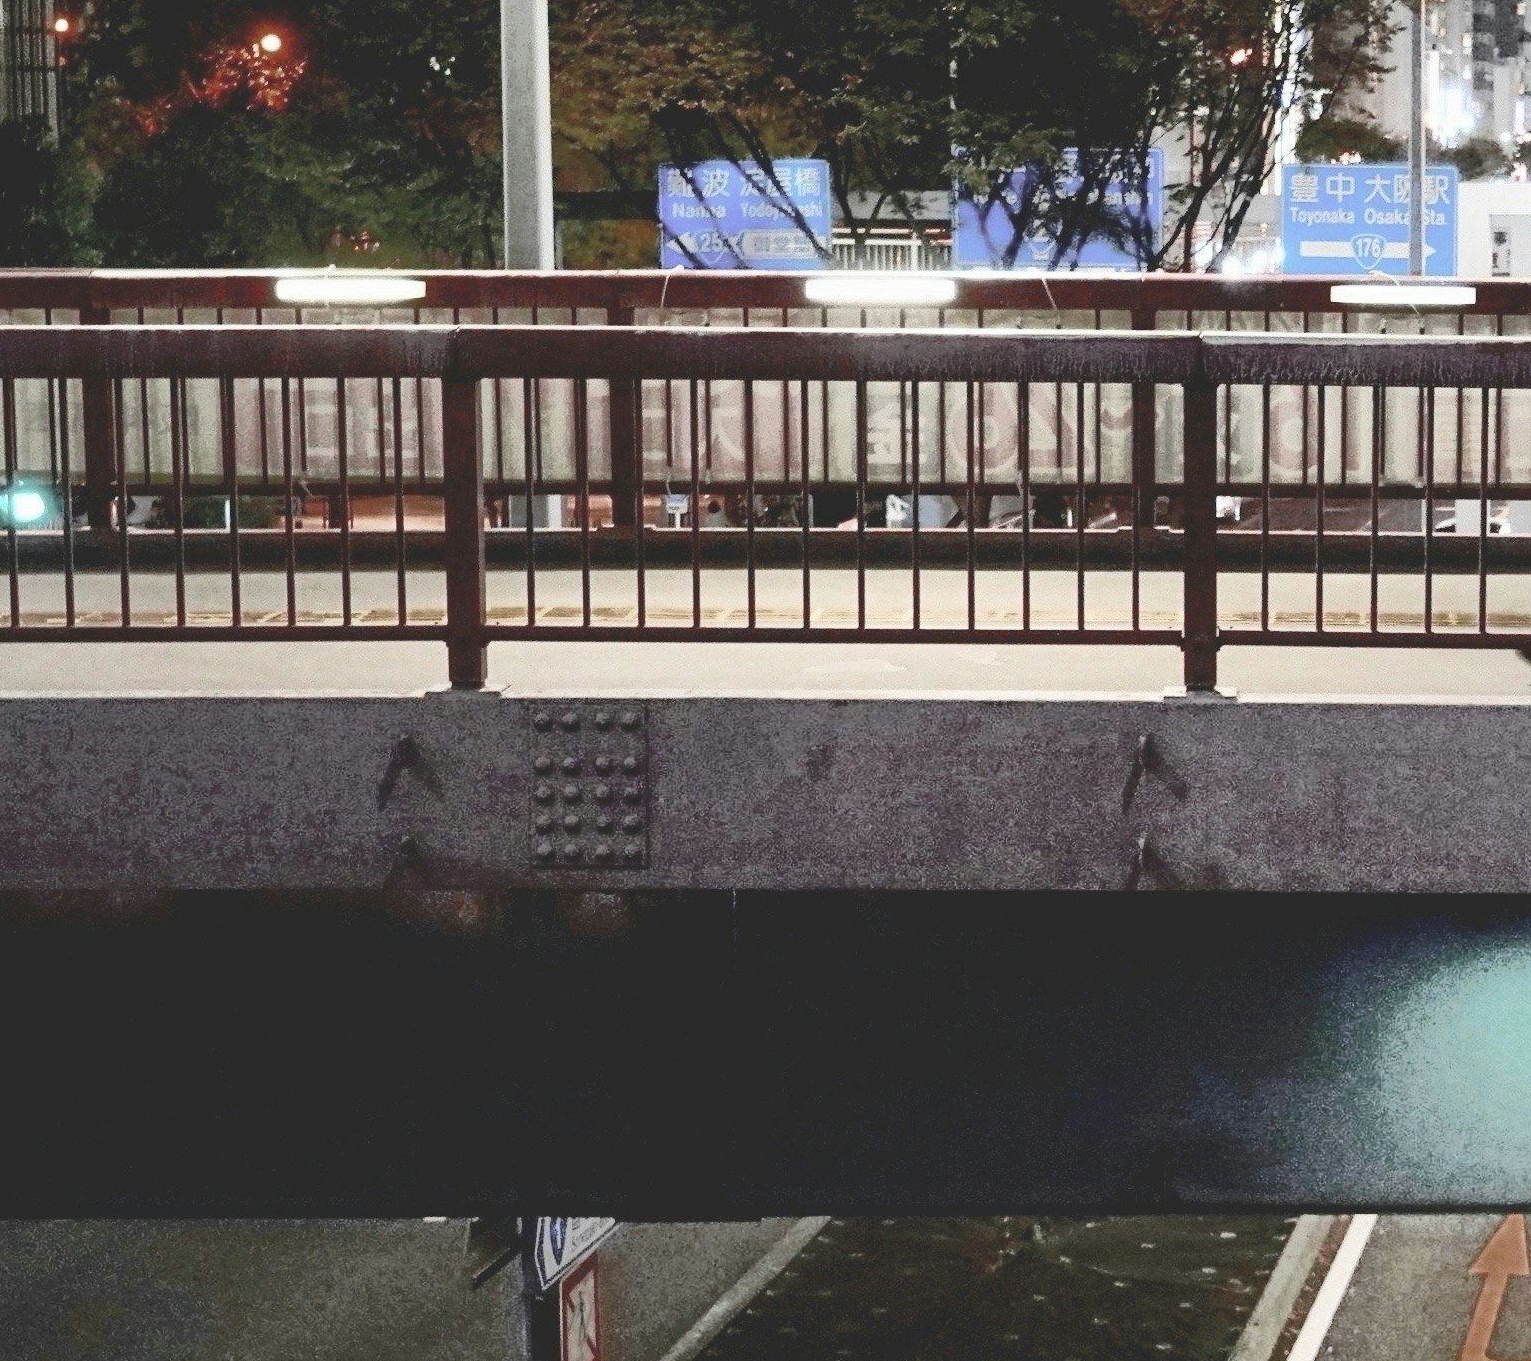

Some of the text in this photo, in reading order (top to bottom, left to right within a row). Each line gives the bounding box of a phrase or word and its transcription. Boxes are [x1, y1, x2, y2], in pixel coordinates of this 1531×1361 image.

[1290, 172, 1355, 203] 豊中
[1290, 207, 1355, 226] Toyonaka
[1356, 239, 1382, 258] 176
